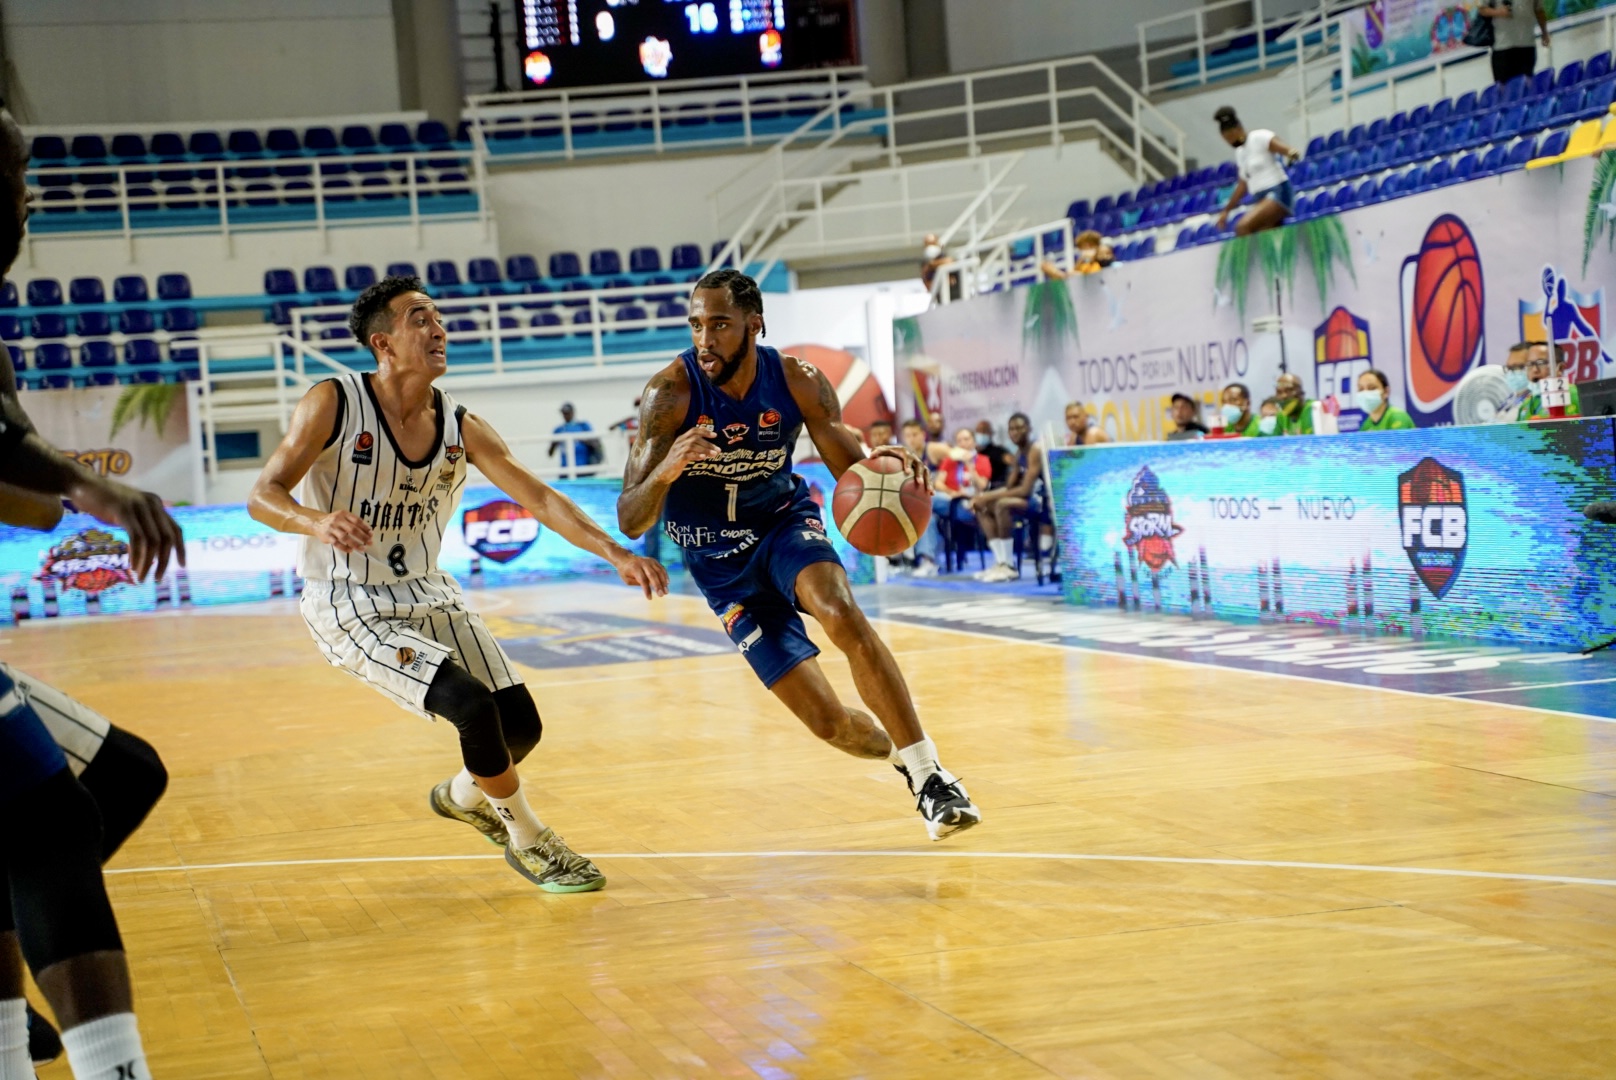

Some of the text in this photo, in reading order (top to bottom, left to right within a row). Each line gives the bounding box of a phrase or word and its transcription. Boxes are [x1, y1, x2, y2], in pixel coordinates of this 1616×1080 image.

[1079, 353, 1139, 394] TODOS
[1178, 338, 1249, 385] NUEVO
[724, 483, 739, 522] 1
[1208, 495, 1356, 520] TODOS NUEVO
[199, 534, 277, 552] TODOS
[465, 518, 540, 547] FCB
[1402, 504, 1467, 549] FCB
[387, 543, 410, 577] 8
